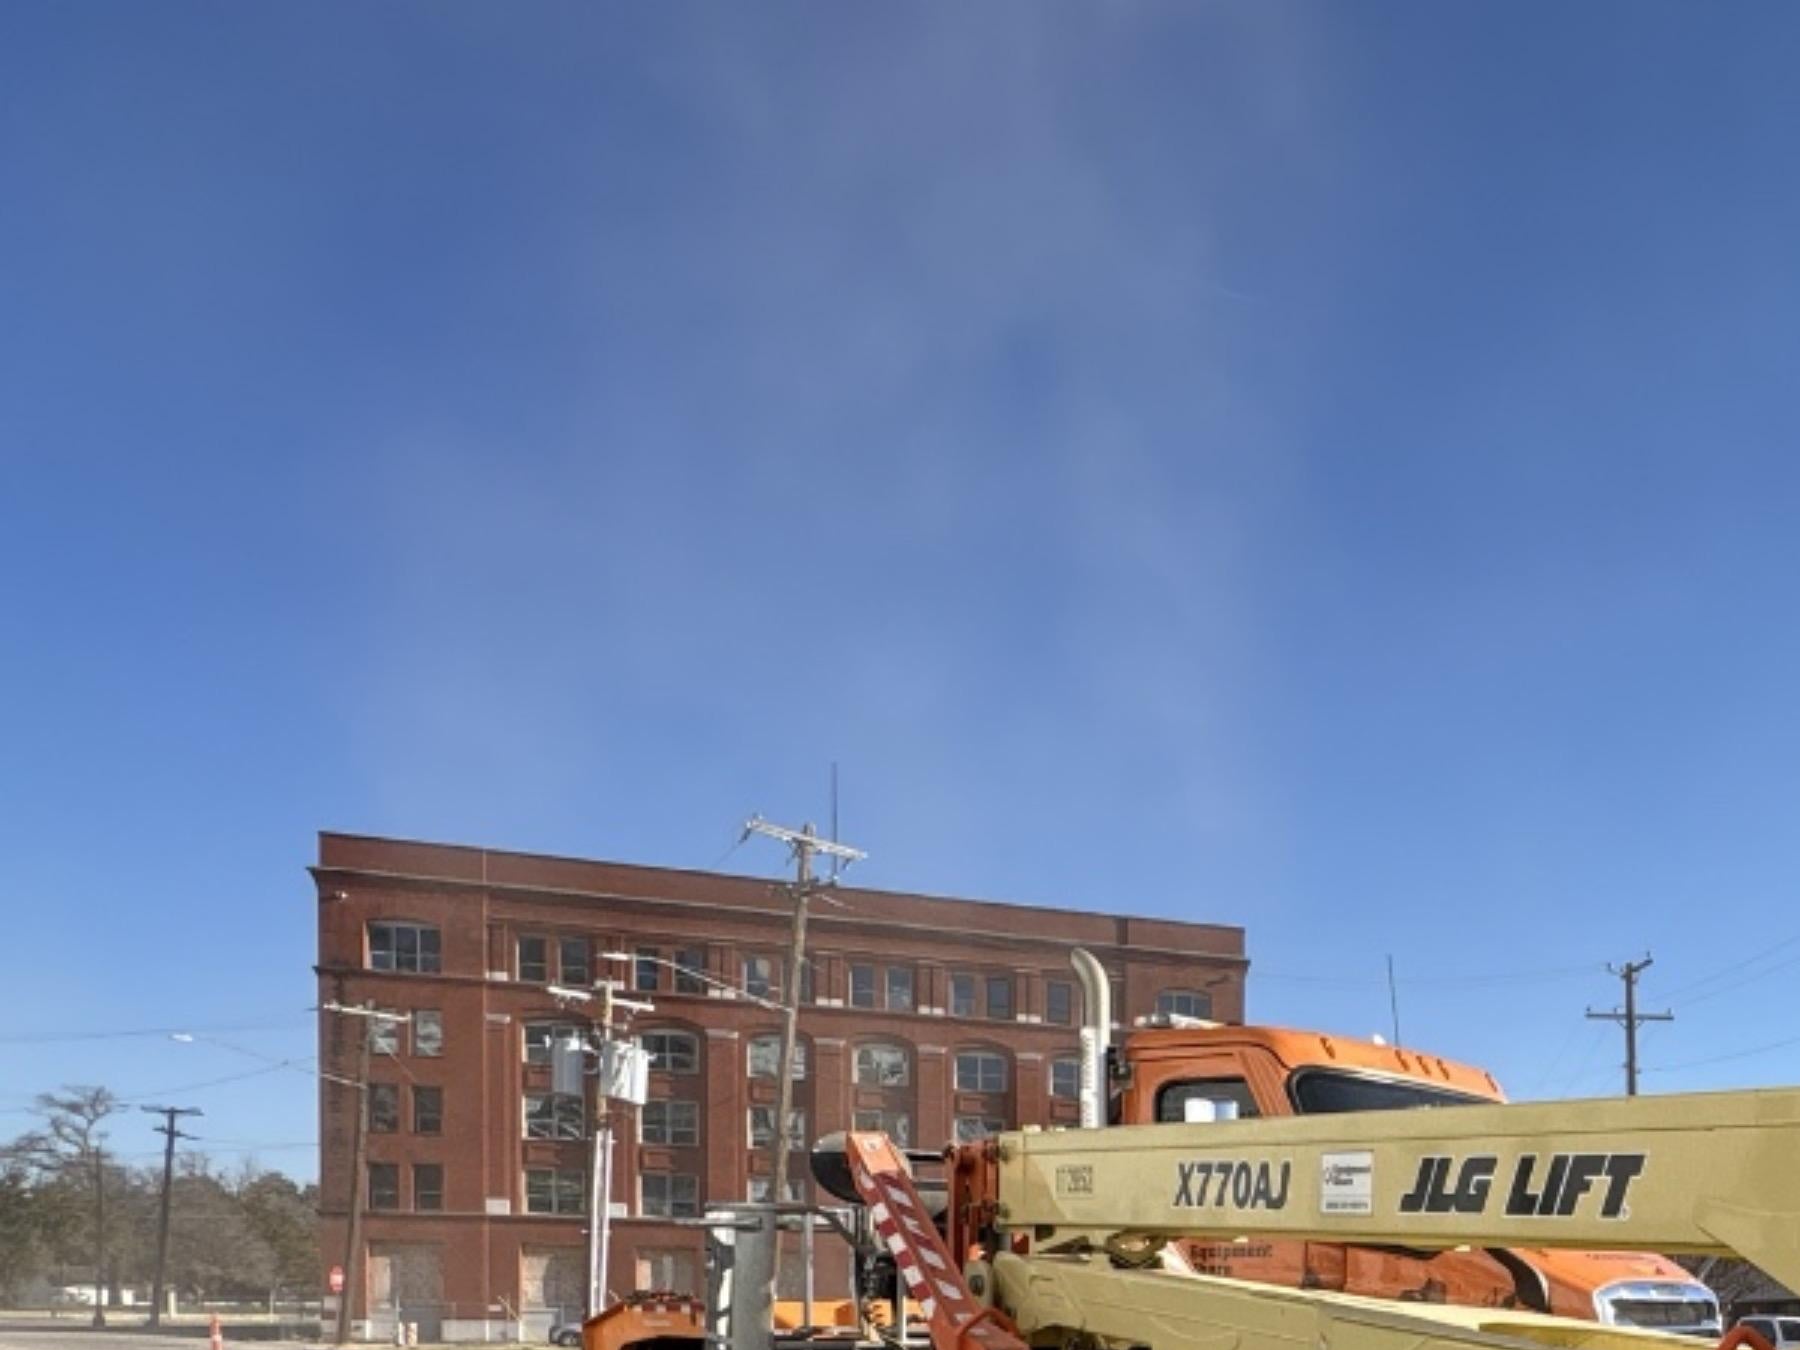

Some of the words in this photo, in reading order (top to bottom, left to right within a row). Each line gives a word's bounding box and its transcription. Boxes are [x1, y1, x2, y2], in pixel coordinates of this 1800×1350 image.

[1173, 1160, 1291, 1210] X770AJ
[1399, 1156, 1498, 1214] JLG
[1504, 1153, 1646, 1218] LIFT
